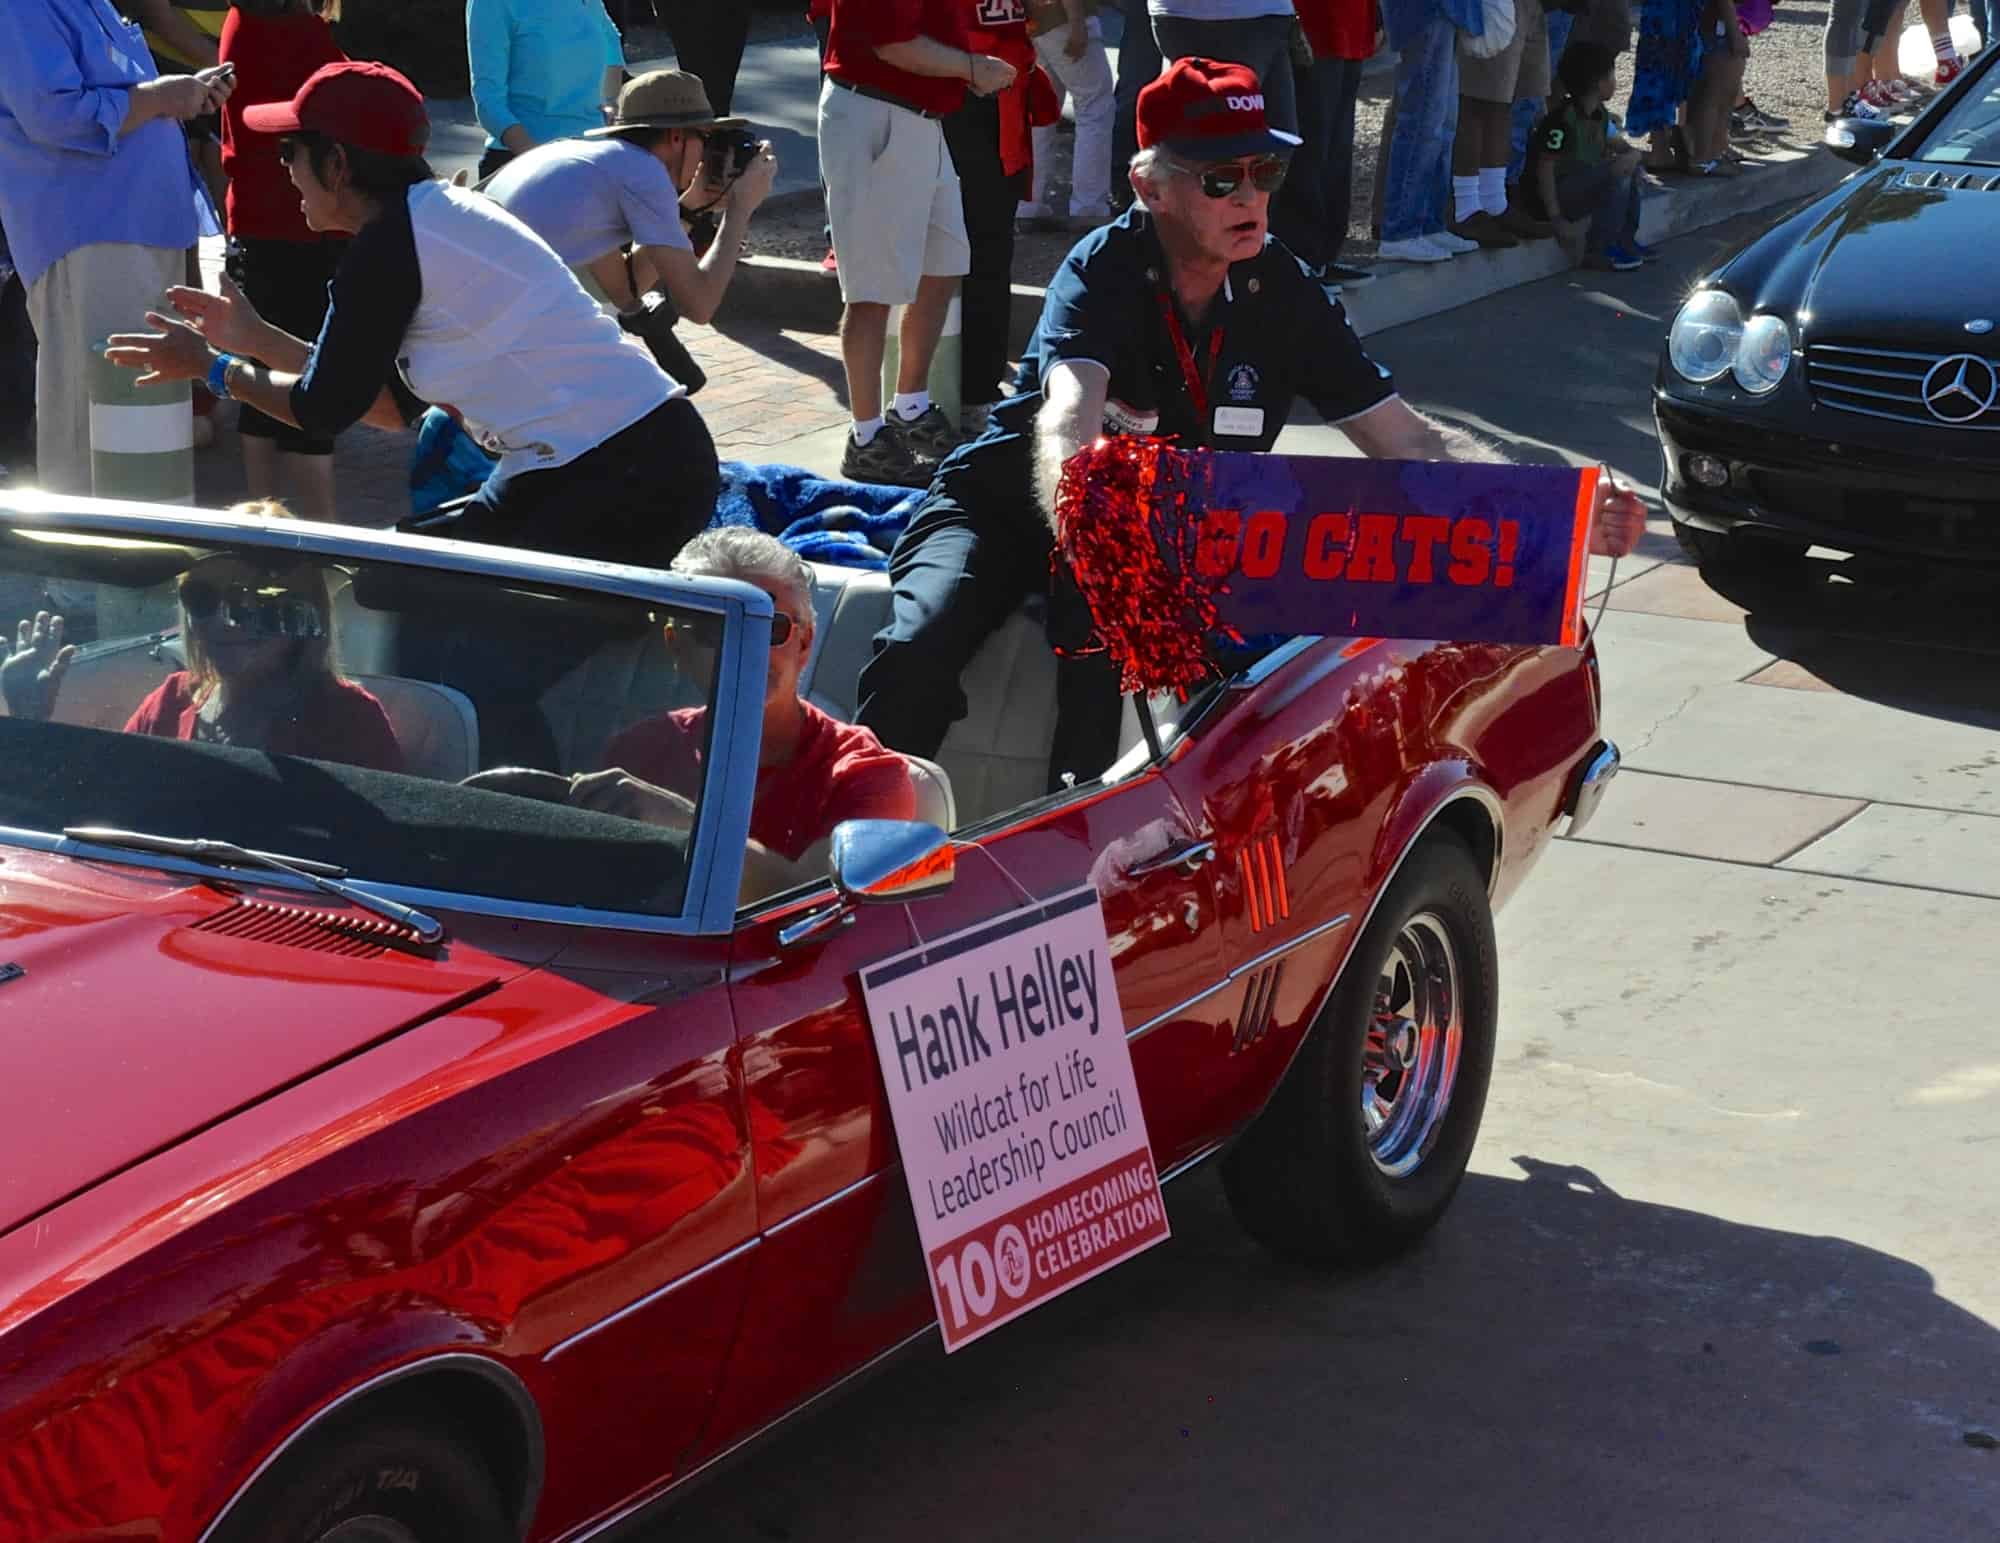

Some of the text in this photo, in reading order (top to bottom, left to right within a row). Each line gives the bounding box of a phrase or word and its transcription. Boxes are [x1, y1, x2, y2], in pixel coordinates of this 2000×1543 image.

[1546, 129, 1564, 149] 3
[1303, 512, 1520, 587] CATS!
[889, 943, 1099, 1093] Hank Helley
[933, 1048, 1097, 1155] Wildcat for Life
[928, 1087, 1127, 1221] Leadership Council
[1026, 1161, 1153, 1247] HOMECOMING
[1035, 1194, 1161, 1280] CELEBRATION
